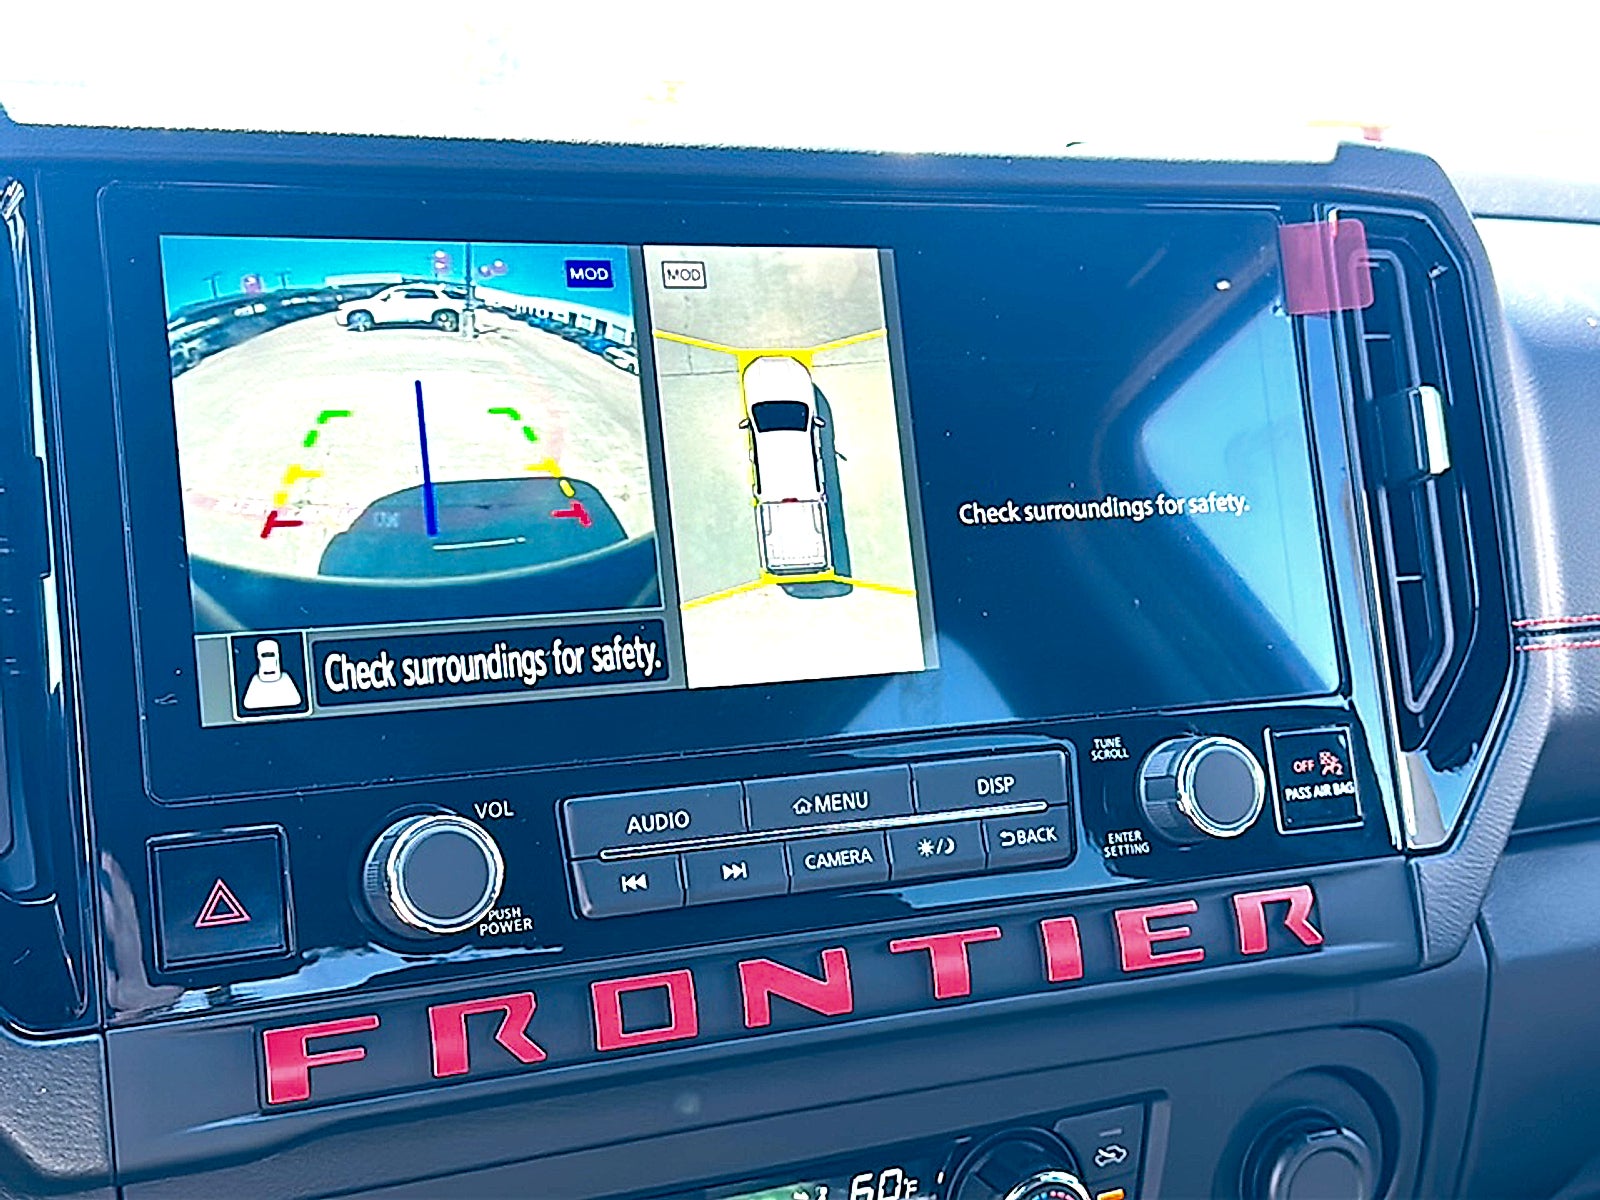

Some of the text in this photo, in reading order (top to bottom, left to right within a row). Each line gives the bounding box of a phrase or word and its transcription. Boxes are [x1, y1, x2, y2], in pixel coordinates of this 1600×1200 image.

[569, 267, 609, 281] MOD
[667, 268, 701, 282] MOD
[959, 491, 1250, 525] Check surroundings for safety.
[324, 634, 662, 692] Check surroundings for safety.
[1093, 736, 1121, 749] TUNE
[1090, 746, 1129, 761] SCROLL
[1293, 759, 1315, 773] OFF
[976, 776, 1015, 796] DISP
[1284, 780, 1356, 802] PASS AIR BAG
[474, 800, 515, 820] VOL
[814, 791, 869, 813] MENU
[626, 810, 690, 835] AUDIO
[1016, 826, 1058, 845] BACK
[1107, 830, 1143, 845] ENTER
[804, 847, 874, 870] CAMERA
[1103, 841, 1150, 858] SETTING
[488, 906, 522, 921] PUSH
[479, 917, 534, 937] POWER
[260, 883, 1325, 1107] FRONTIER
